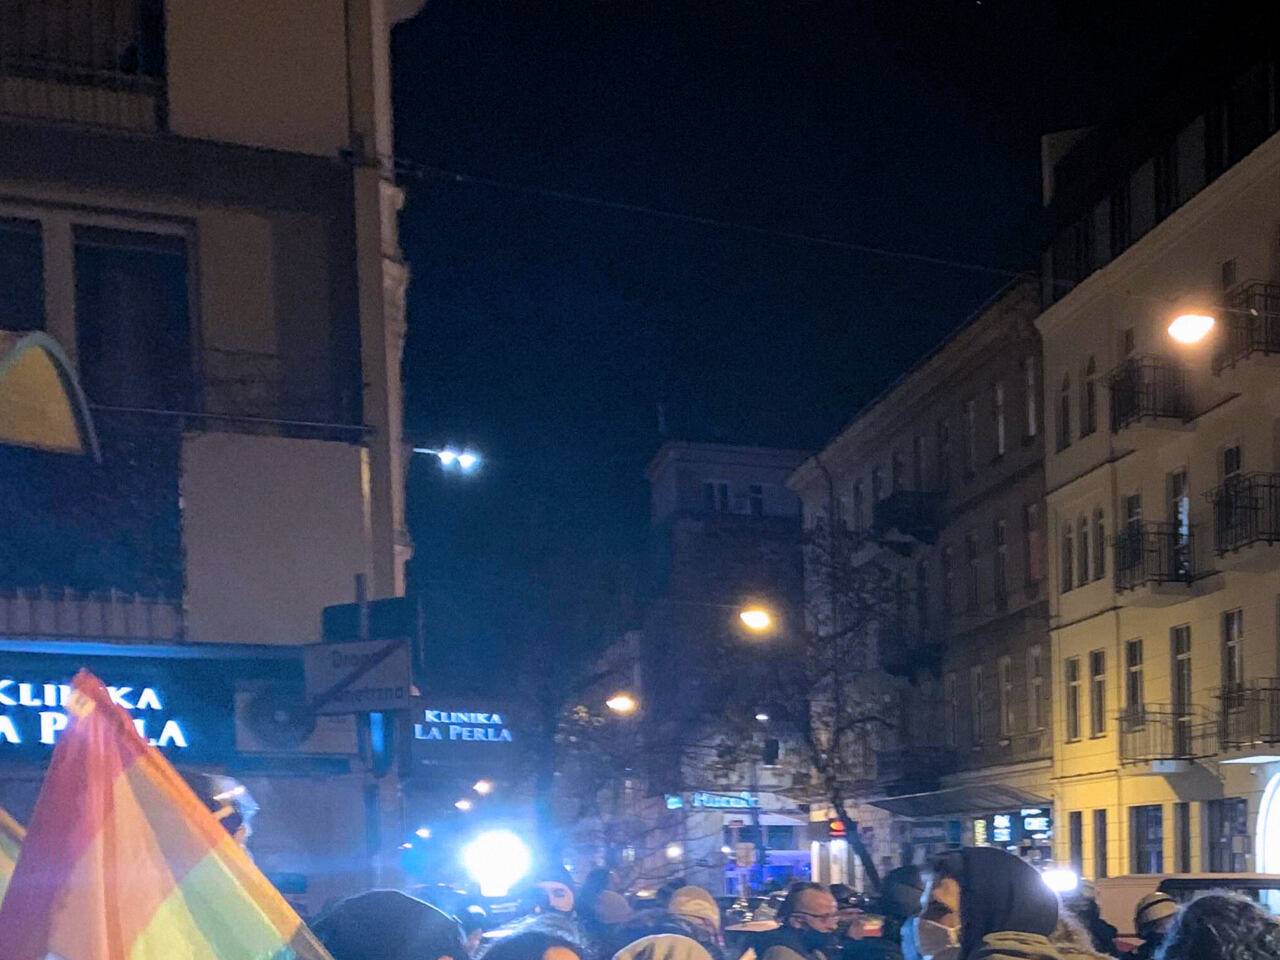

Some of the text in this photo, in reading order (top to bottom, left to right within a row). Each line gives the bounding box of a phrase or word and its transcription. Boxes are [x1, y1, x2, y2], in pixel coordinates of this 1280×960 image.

[0, 679, 163, 710] KLIKA
[0, 711, 188, 747] A PLA
[425, 710, 503, 725] KLINIKA
[414, 724, 513, 742] LA PERLA
